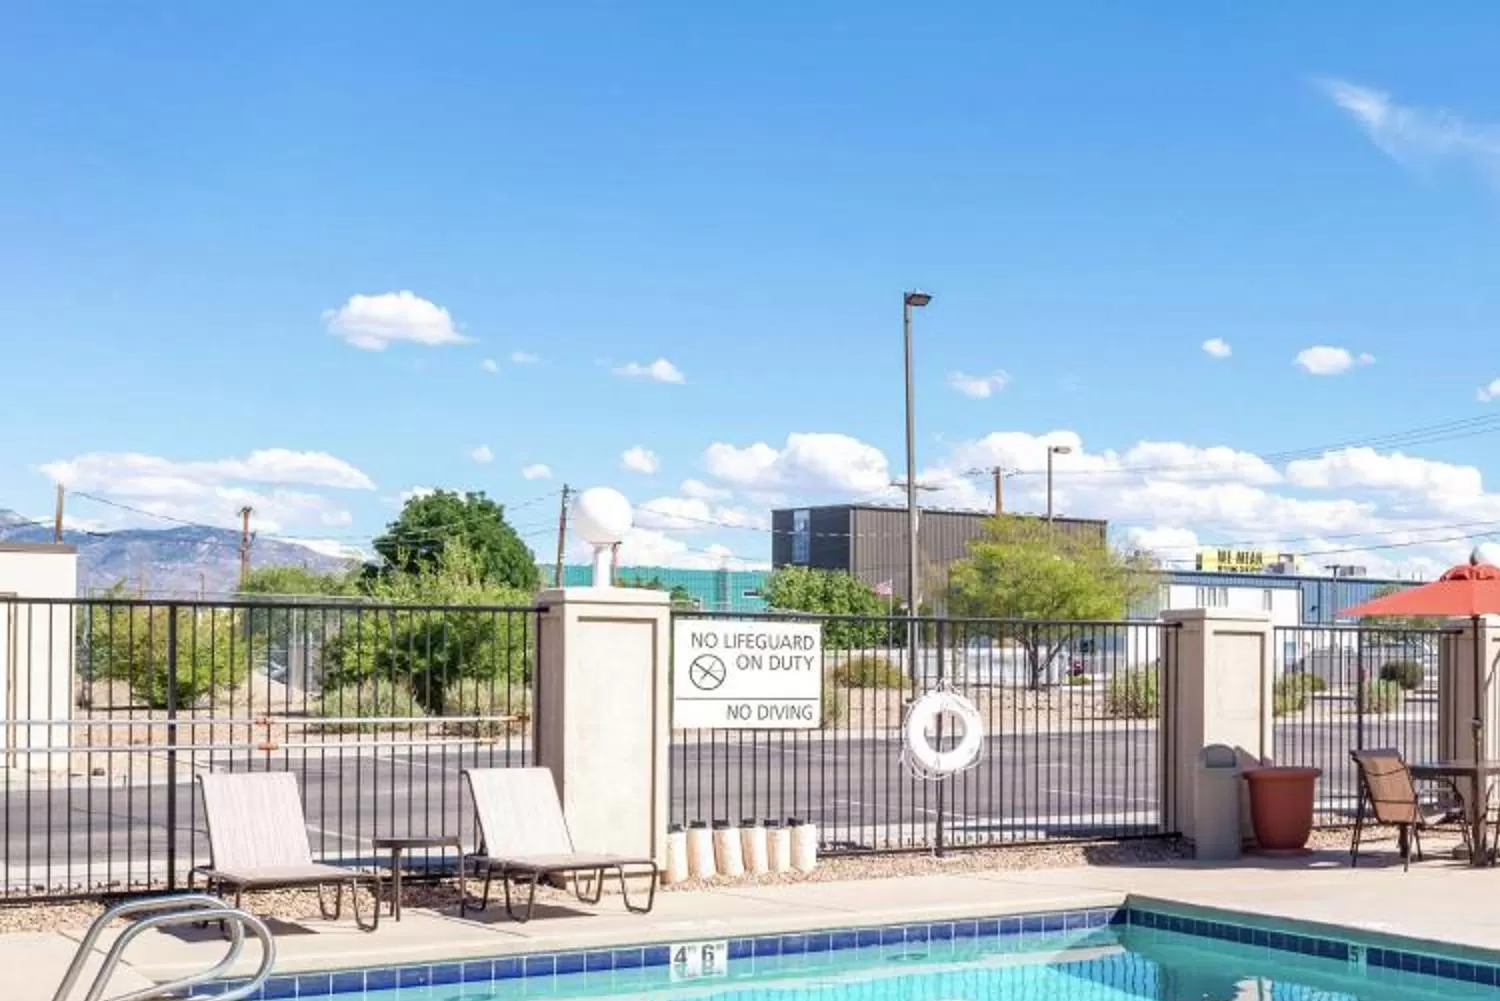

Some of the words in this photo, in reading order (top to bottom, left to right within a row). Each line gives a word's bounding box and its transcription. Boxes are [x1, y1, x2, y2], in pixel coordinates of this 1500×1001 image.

[691, 632, 718, 649] NO
[723, 633, 815, 651] LIFEGUARD
[736, 654, 763, 671] ON
[769, 655, 815, 671] DUTY
[726, 704, 752, 720] NO
[757, 704, 813, 721] DIVING
[673, 945, 687, 963] 4
[701, 944, 715, 961] 6
